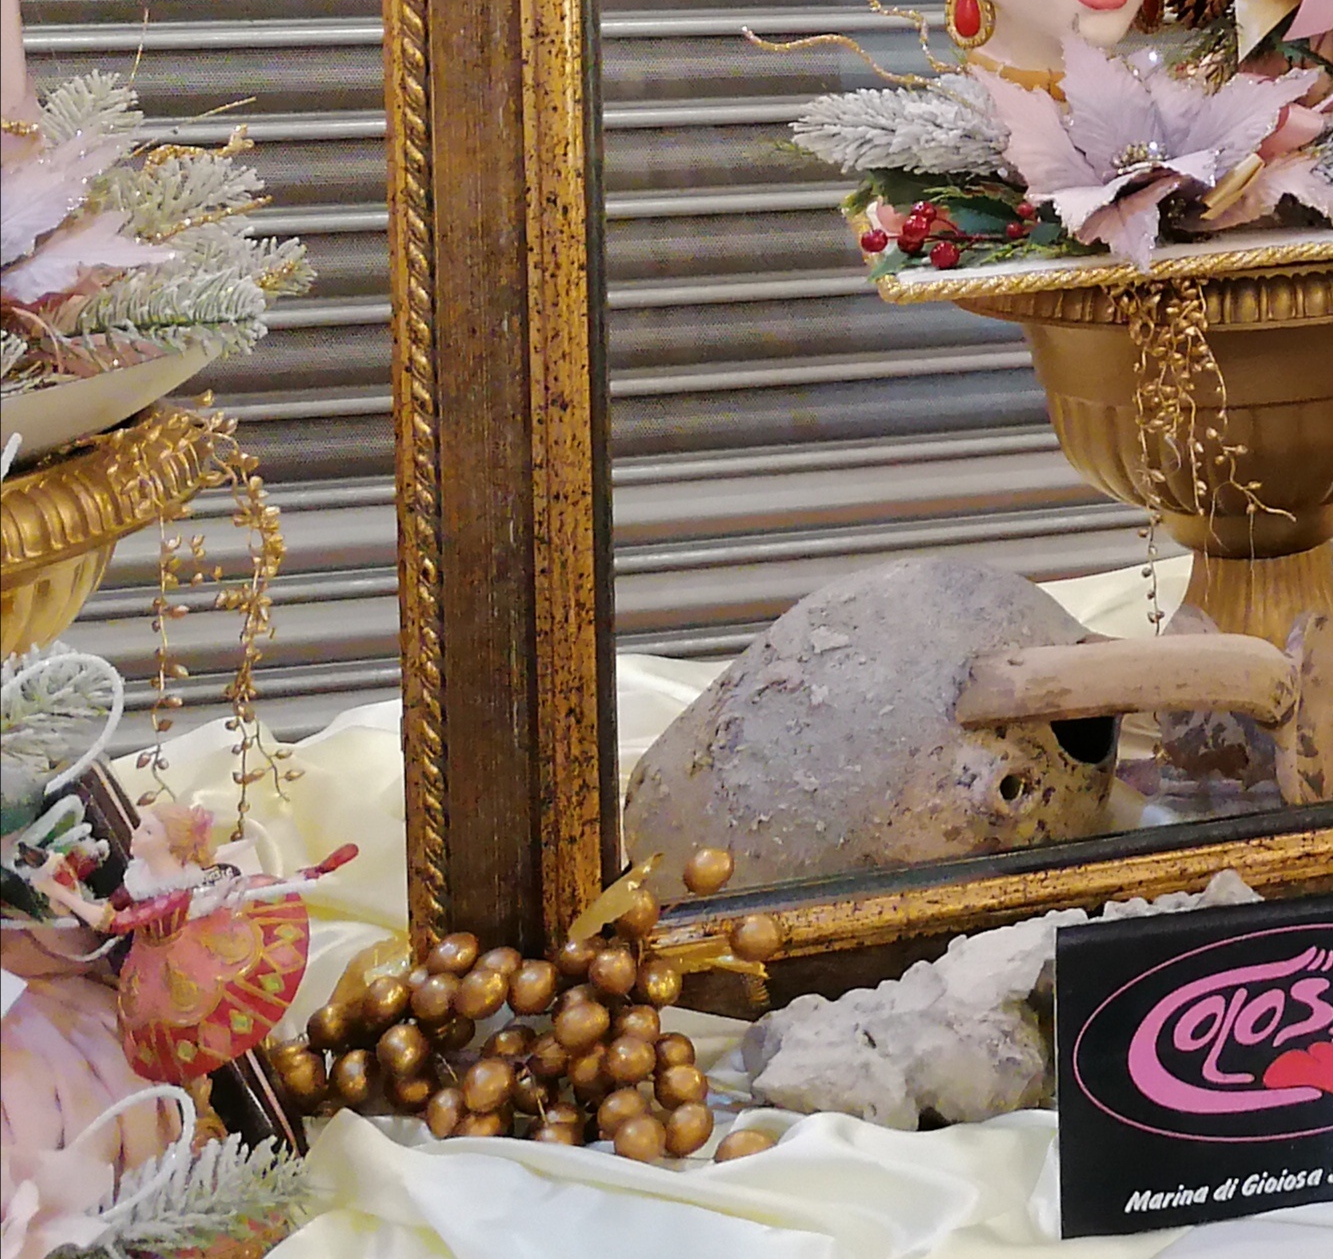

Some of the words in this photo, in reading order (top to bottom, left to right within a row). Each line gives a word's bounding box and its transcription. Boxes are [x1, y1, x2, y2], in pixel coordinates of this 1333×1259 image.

[1124, 1183, 1208, 1214] Marina
[1213, 1178, 1237, 1203] di
[1241, 1166, 1321, 1199] Gioiosa
